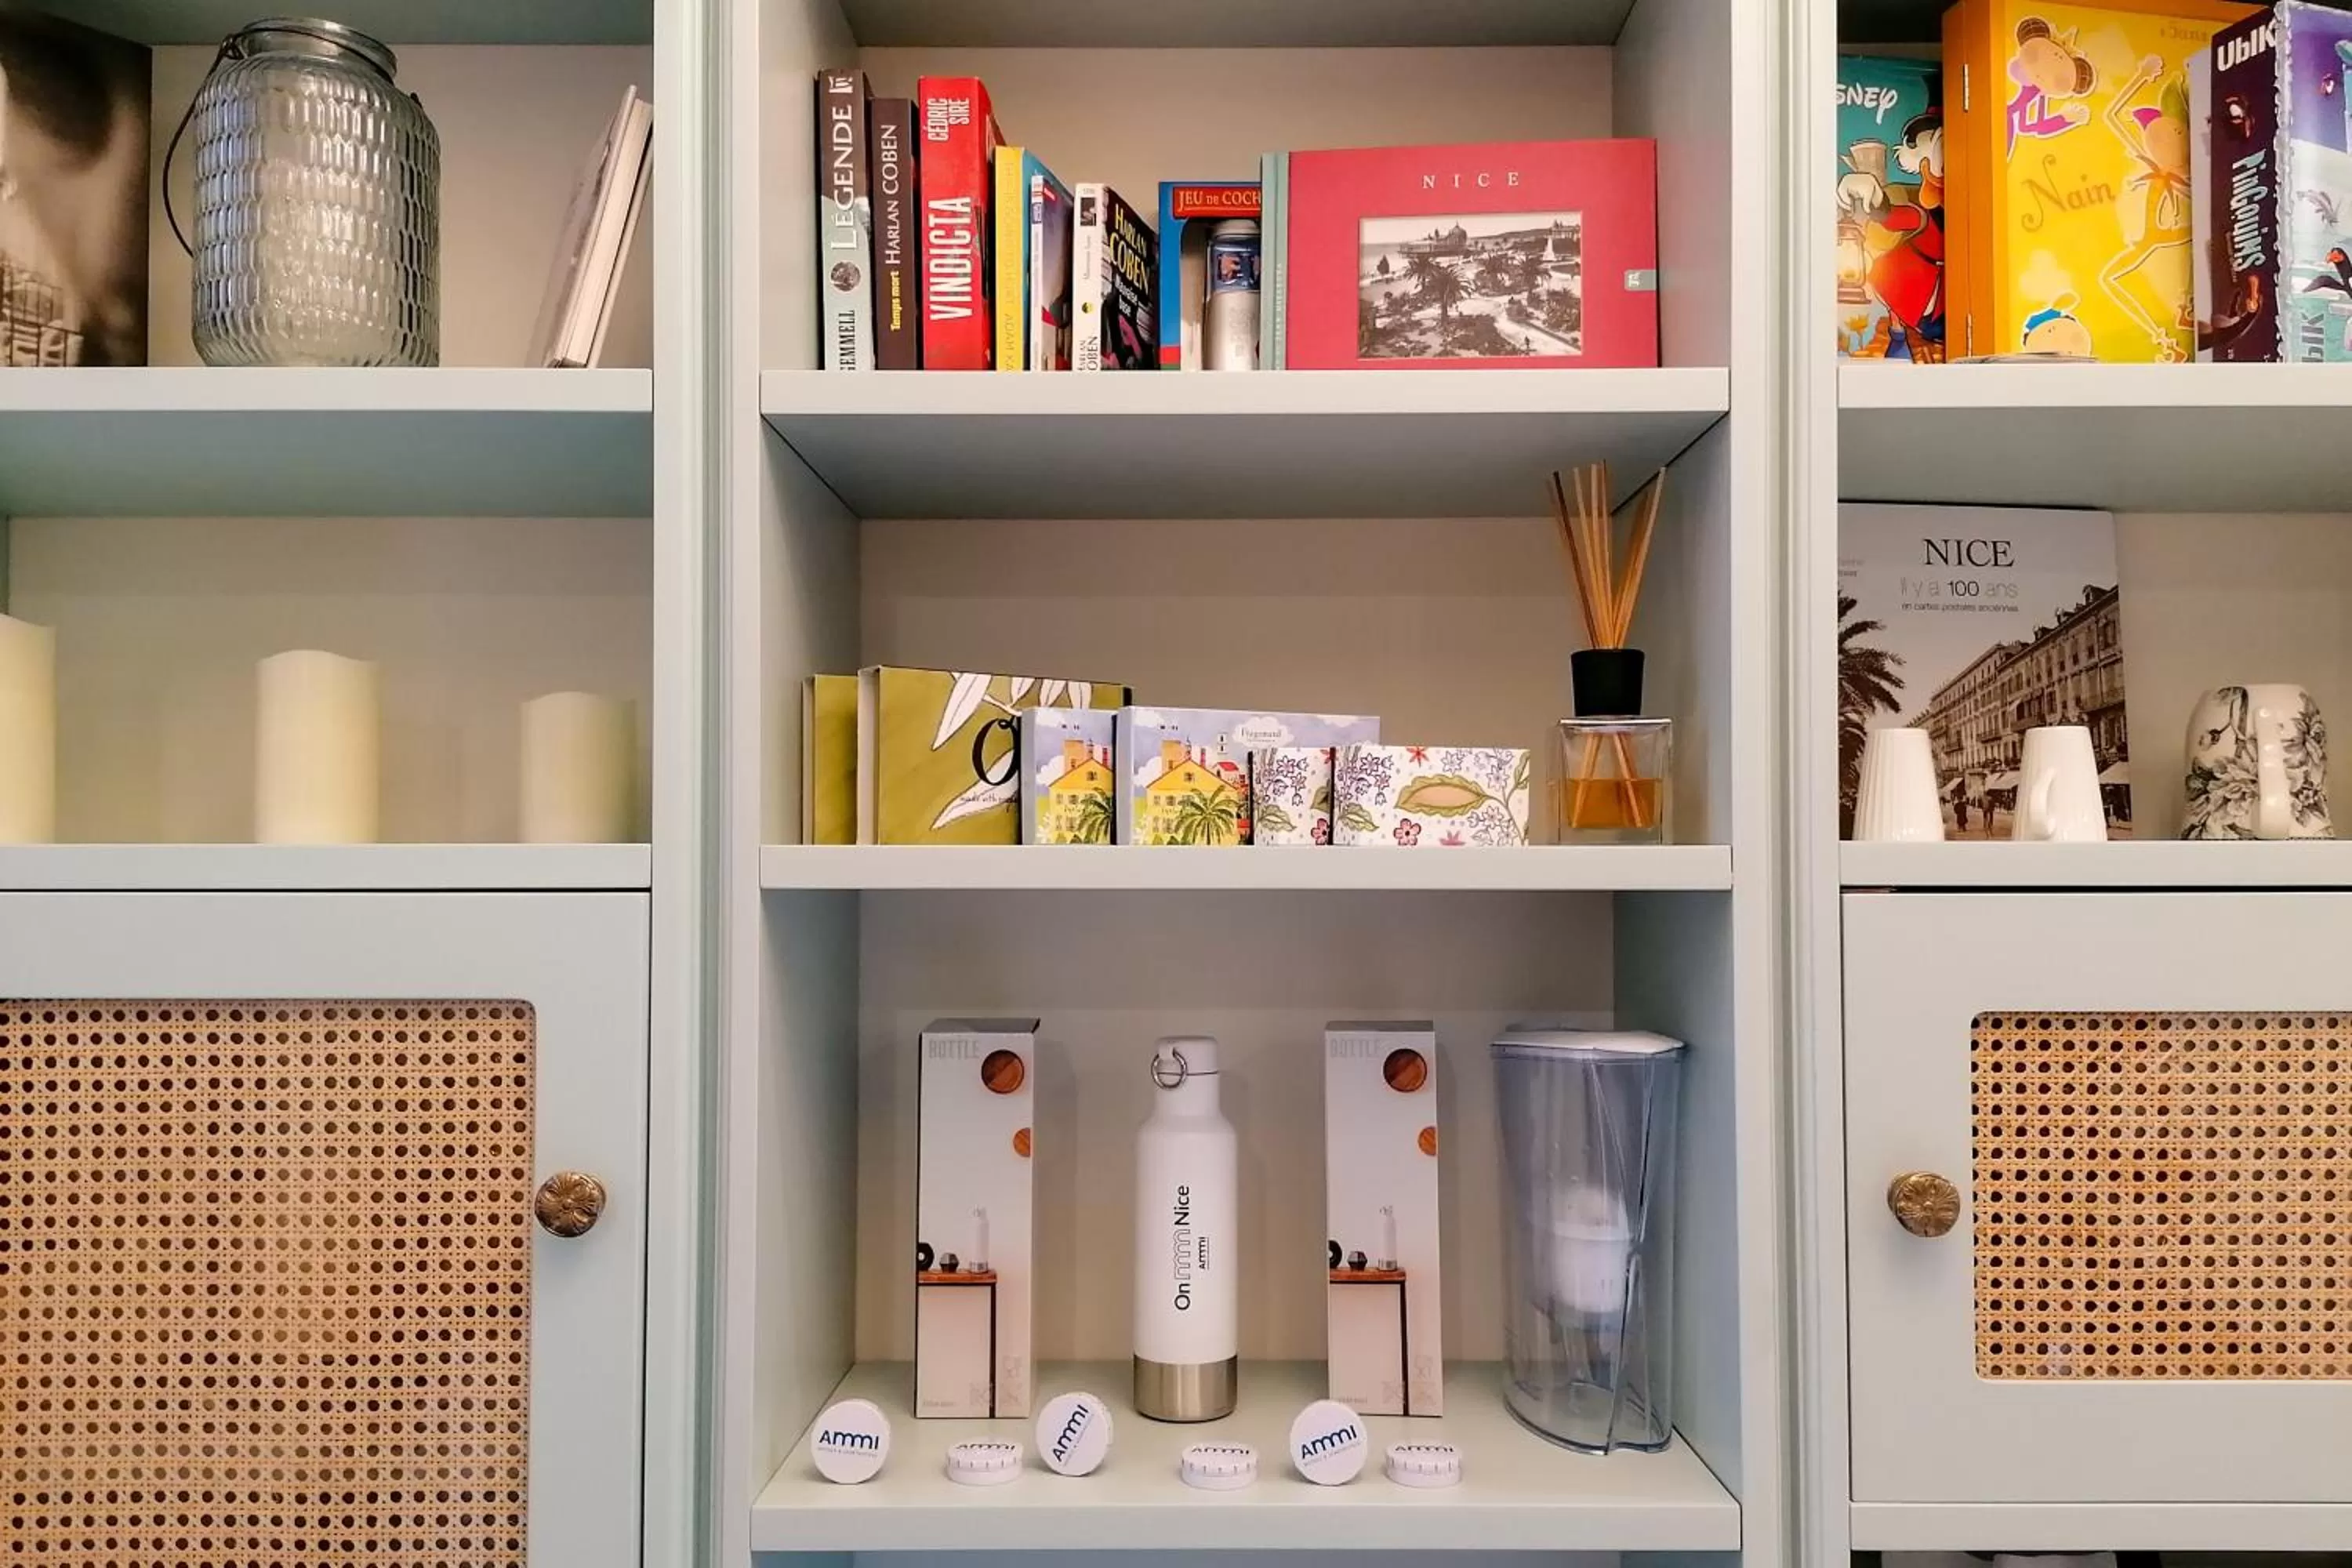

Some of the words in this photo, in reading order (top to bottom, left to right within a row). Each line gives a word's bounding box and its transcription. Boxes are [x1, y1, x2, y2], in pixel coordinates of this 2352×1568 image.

[949, 98, 970, 125] SIRE
[1837, 82, 1898, 125] SNEY
[880, 125, 900, 194] COBEN
[1422, 172, 1519, 189] NICE
[2020, 153, 2116, 233] Nain
[1178, 191, 1203, 212] JEU
[1222, 191, 1261, 205] COCH
[885, 200, 901, 264] HARLAN
[1114, 203, 1147, 260] HARLAN
[928, 197, 972, 321] VINDICTA
[1109, 232, 1149, 296] COBEN
[890, 270, 901, 296] mort
[891, 299, 902, 331] Temps
[1004, 354, 1016, 371] KA
[1087, 336, 1098, 371] OBEN
[1922, 539, 2015, 567] NICE
[1913, 582, 1923, 598] y
[1929, 580, 1940, 597] a
[1947, 580, 1980, 597] 100
[1984, 583, 2019, 598] ans
[928, 1039, 980, 1059] BOTTLE
[1174, 1185, 1190, 1225] Nice
[1174, 1283, 1191, 1311] On
